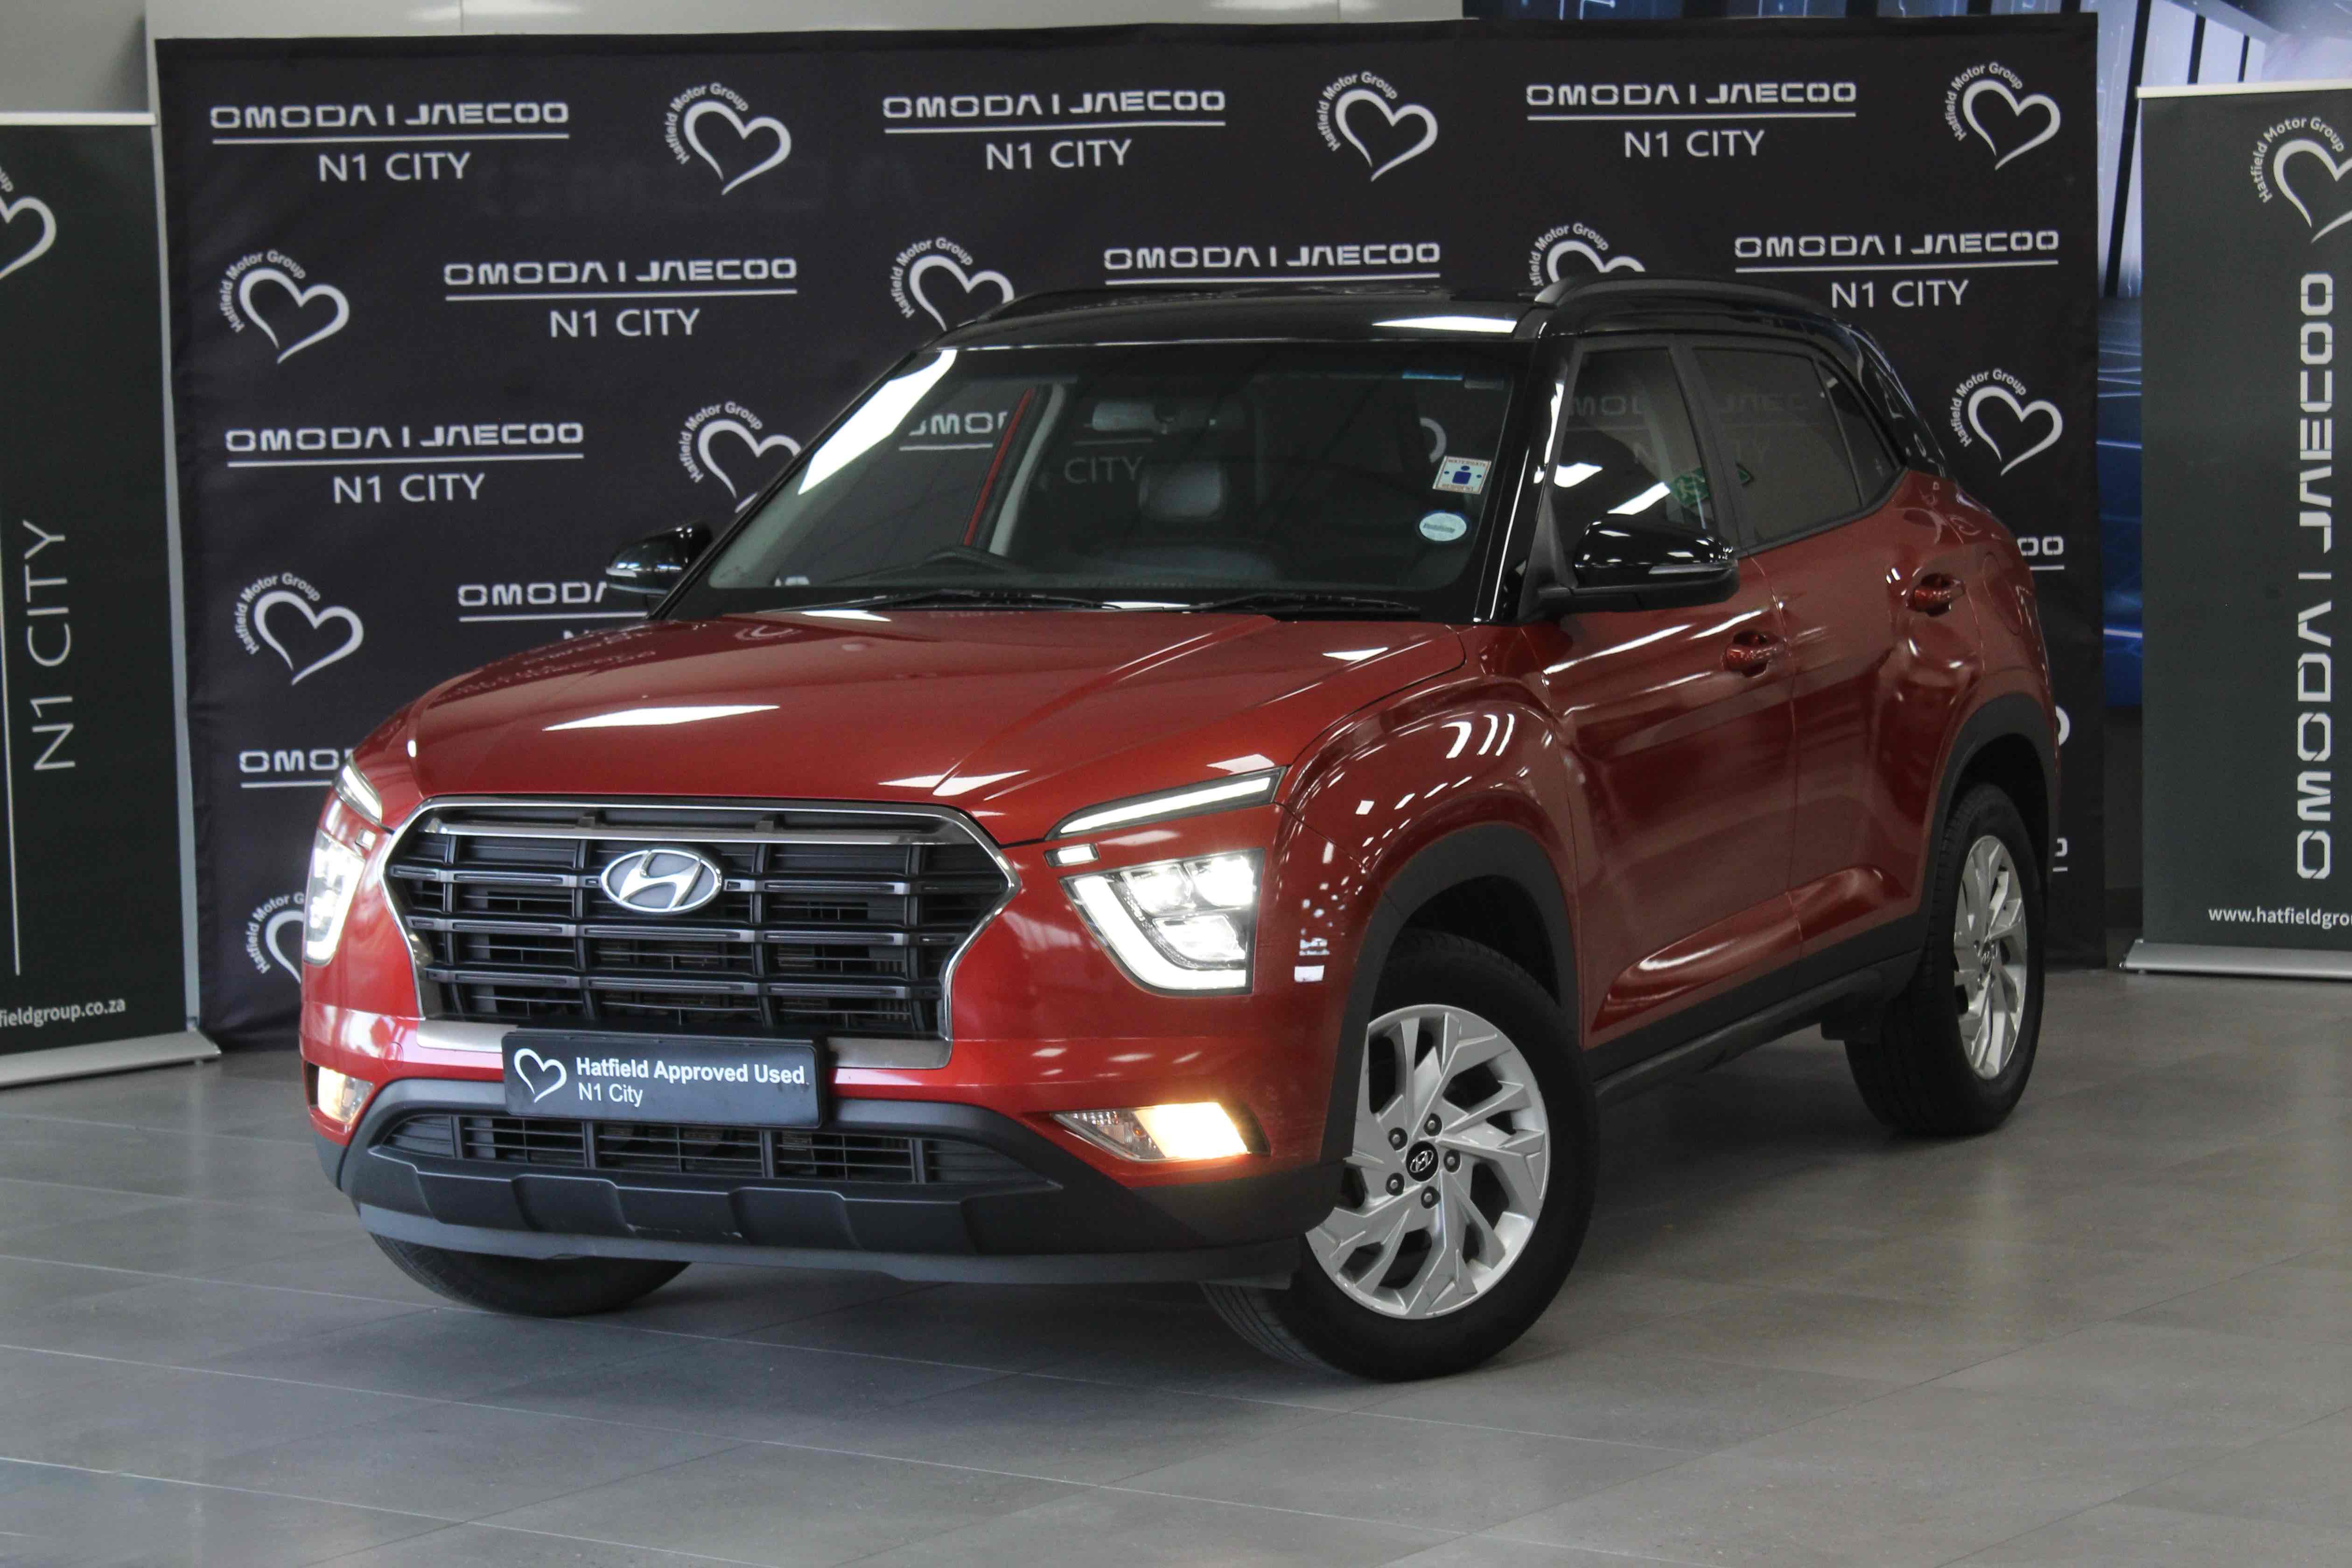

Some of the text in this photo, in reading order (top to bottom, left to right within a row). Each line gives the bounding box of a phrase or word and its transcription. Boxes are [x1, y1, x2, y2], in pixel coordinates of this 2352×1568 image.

[882, 94, 1043, 119] OMODA
[1069, 90, 1225, 114] JAECOO
[1526, 84, 1680, 106] OMODA
[1705, 82, 1856, 104] JAECOO
[1945, 62, 2023, 141] Hatfield Motor Group
[210, 105, 378, 129] OMODA
[405, 102, 569, 126] JAECOO
[665, 82, 749, 164] Hatfield Motor Group
[1316, 71, 1397, 151] Hatfield Motor Group
[986, 139, 1132, 170] N1 CITY
[1624, 129, 1765, 158] N1 CITY
[319, 152, 471, 182] N1 CITY
[2250, 117, 2344, 203] Hatfield Motor Group
[1534, 224, 1569, 251] Motor
[1573, 223, 1609, 251] Group
[1734, 235, 1885, 259] OMODA
[1910, 230, 2059, 255] JAECOO
[1103, 246, 1260, 270] OMODA
[1286, 242, 1441, 267] JAECOO
[443, 261, 609, 286] OMODA
[636, 258, 797, 282] JAECOO
[890, 237, 973, 319] Hatfield Motor Group
[220, 250, 306, 333] Hatfield Motor Group
[1831, 279, 1969, 308] N1 CITY
[550, 308, 700, 338] N1 CITY
[1950, 369, 2027, 447] Hatfield Motor Group
[2299, 273, 2333, 553] JAECOO
[225, 427, 392, 452] OMODA
[420, 422, 584, 447] JAECOO
[679, 401, 763, 483] Hatfield Motor Group
[333, 473, 485, 504] N1 CITY
[234, 572, 320, 654] Hatfield Motor Group
[22, 520, 76, 771] N1 CITY
[2296, 600, 2332, 880] OMODA
[252, 894, 289, 922] Motor
[2208, 906, 2352, 930] www.hatfieldgro
[245, 922, 271, 974] Hatfield
[576, 1057, 650, 1079] Hatfield
[653, 1060, 749, 1085] Approved
[578, 1082, 644, 1108] N1 City
